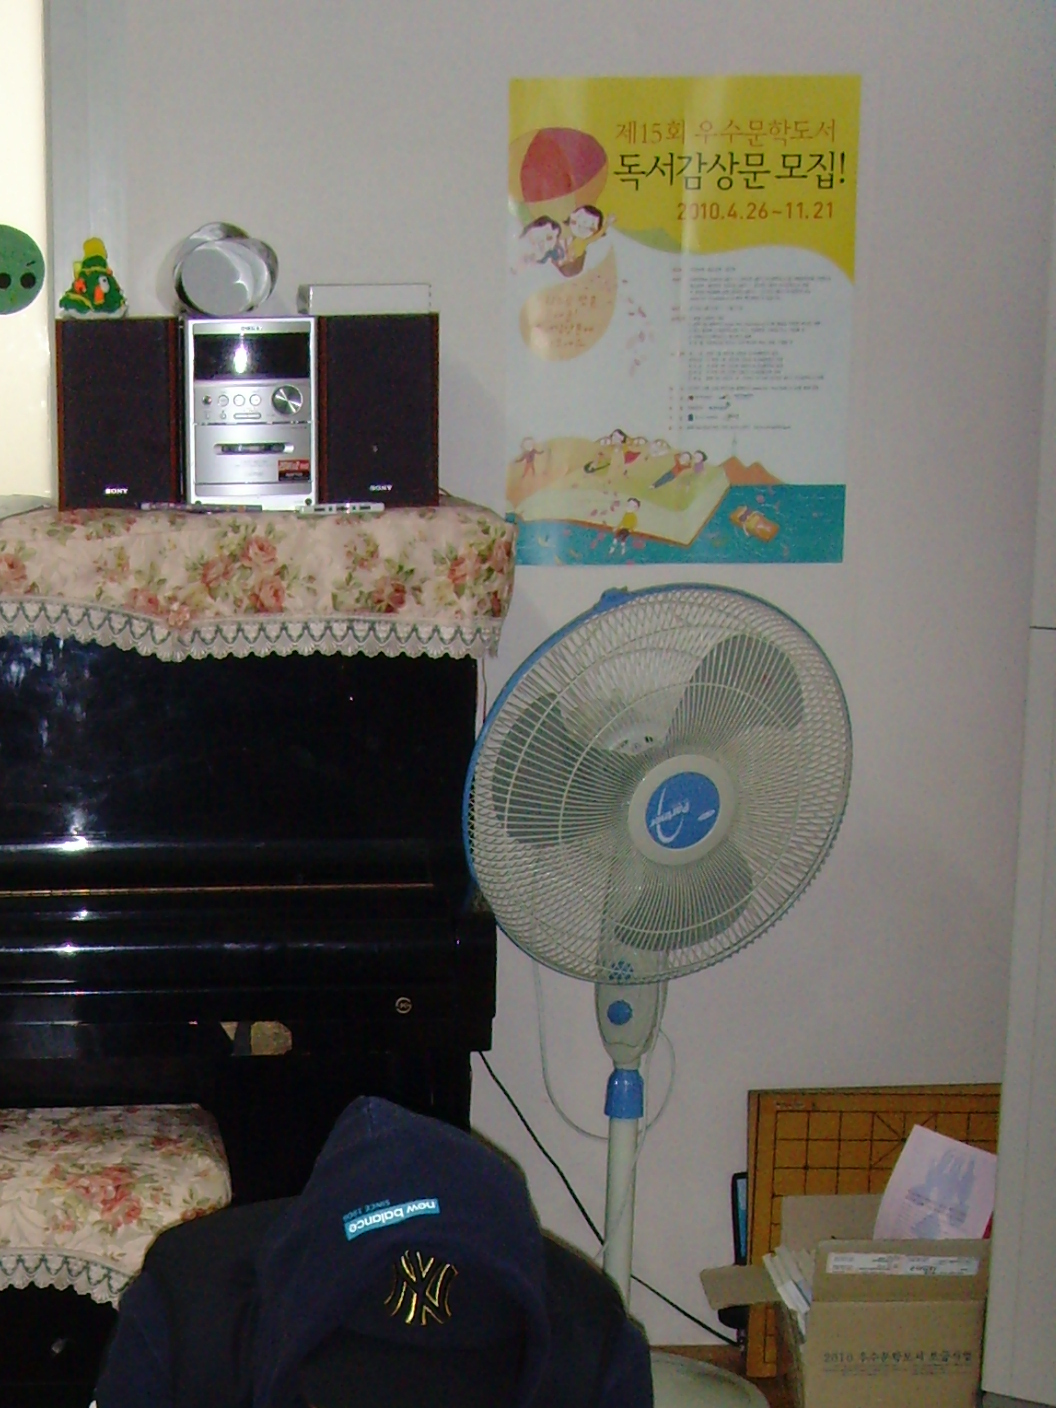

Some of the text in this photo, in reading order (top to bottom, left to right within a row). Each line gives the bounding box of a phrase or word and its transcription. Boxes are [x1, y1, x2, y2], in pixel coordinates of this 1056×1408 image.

[615, 118, 837, 148] 제15회 우수문학도서
[613, 150, 846, 192] 독서감상문 모집!
[676, 201, 834, 220] 2010.4.26~11.21
[104, 487, 128, 495] SONY
[369, 484, 393, 492] SONY
[348, 1200, 436, 1233] new balance
